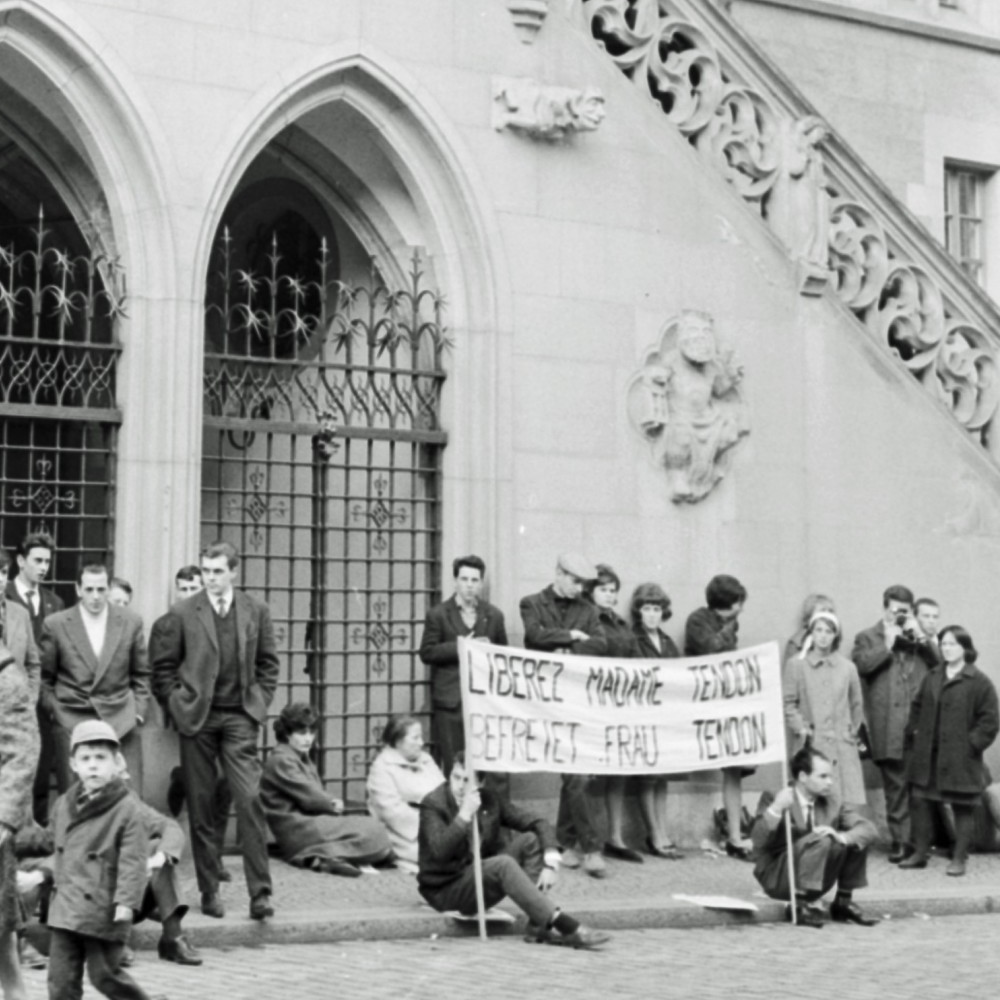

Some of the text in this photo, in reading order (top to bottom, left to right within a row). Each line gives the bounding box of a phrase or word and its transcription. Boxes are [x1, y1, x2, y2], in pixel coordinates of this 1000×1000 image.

[467, 649, 762, 707] LIBEREZ MADAME TENDON
[692, 712, 768, 760] TENDON
